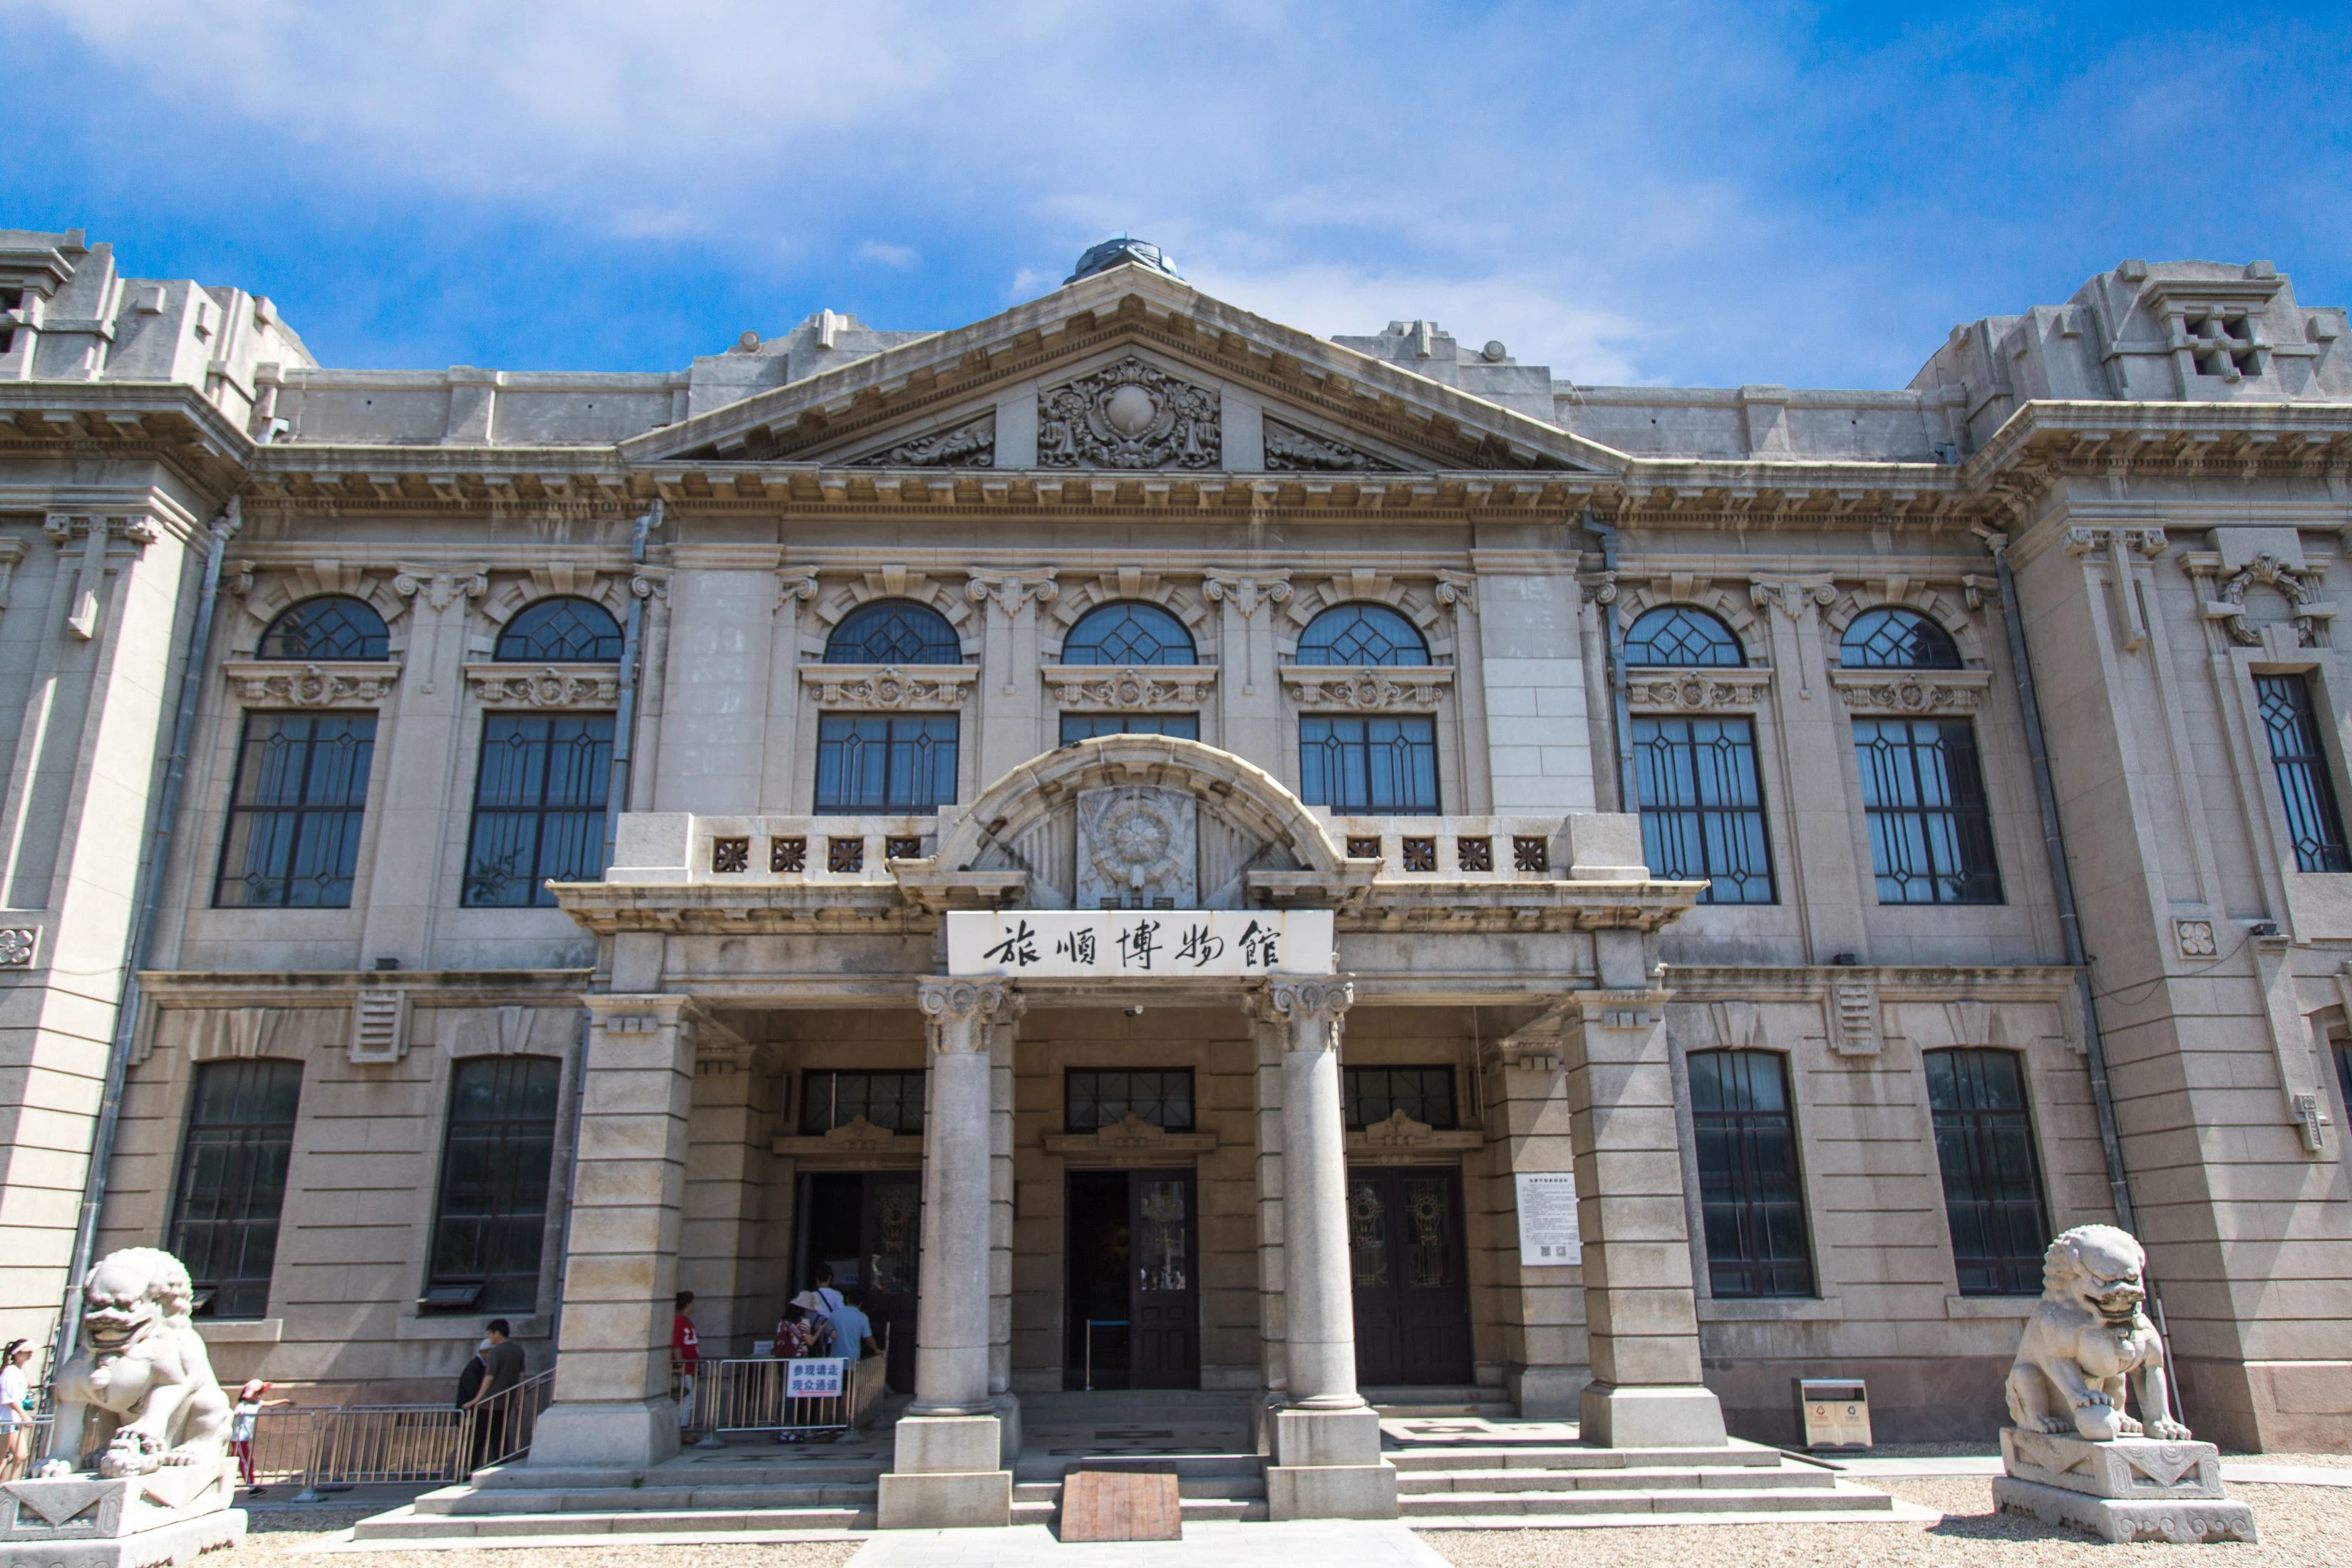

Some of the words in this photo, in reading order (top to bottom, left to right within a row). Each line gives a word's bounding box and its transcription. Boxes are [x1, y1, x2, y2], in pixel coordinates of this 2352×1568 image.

[983, 919, 1281, 970] 旅順博物館
[793, 1364, 838, 1376] 参观请走
[793, 1379, 837, 1391] 观众通道
